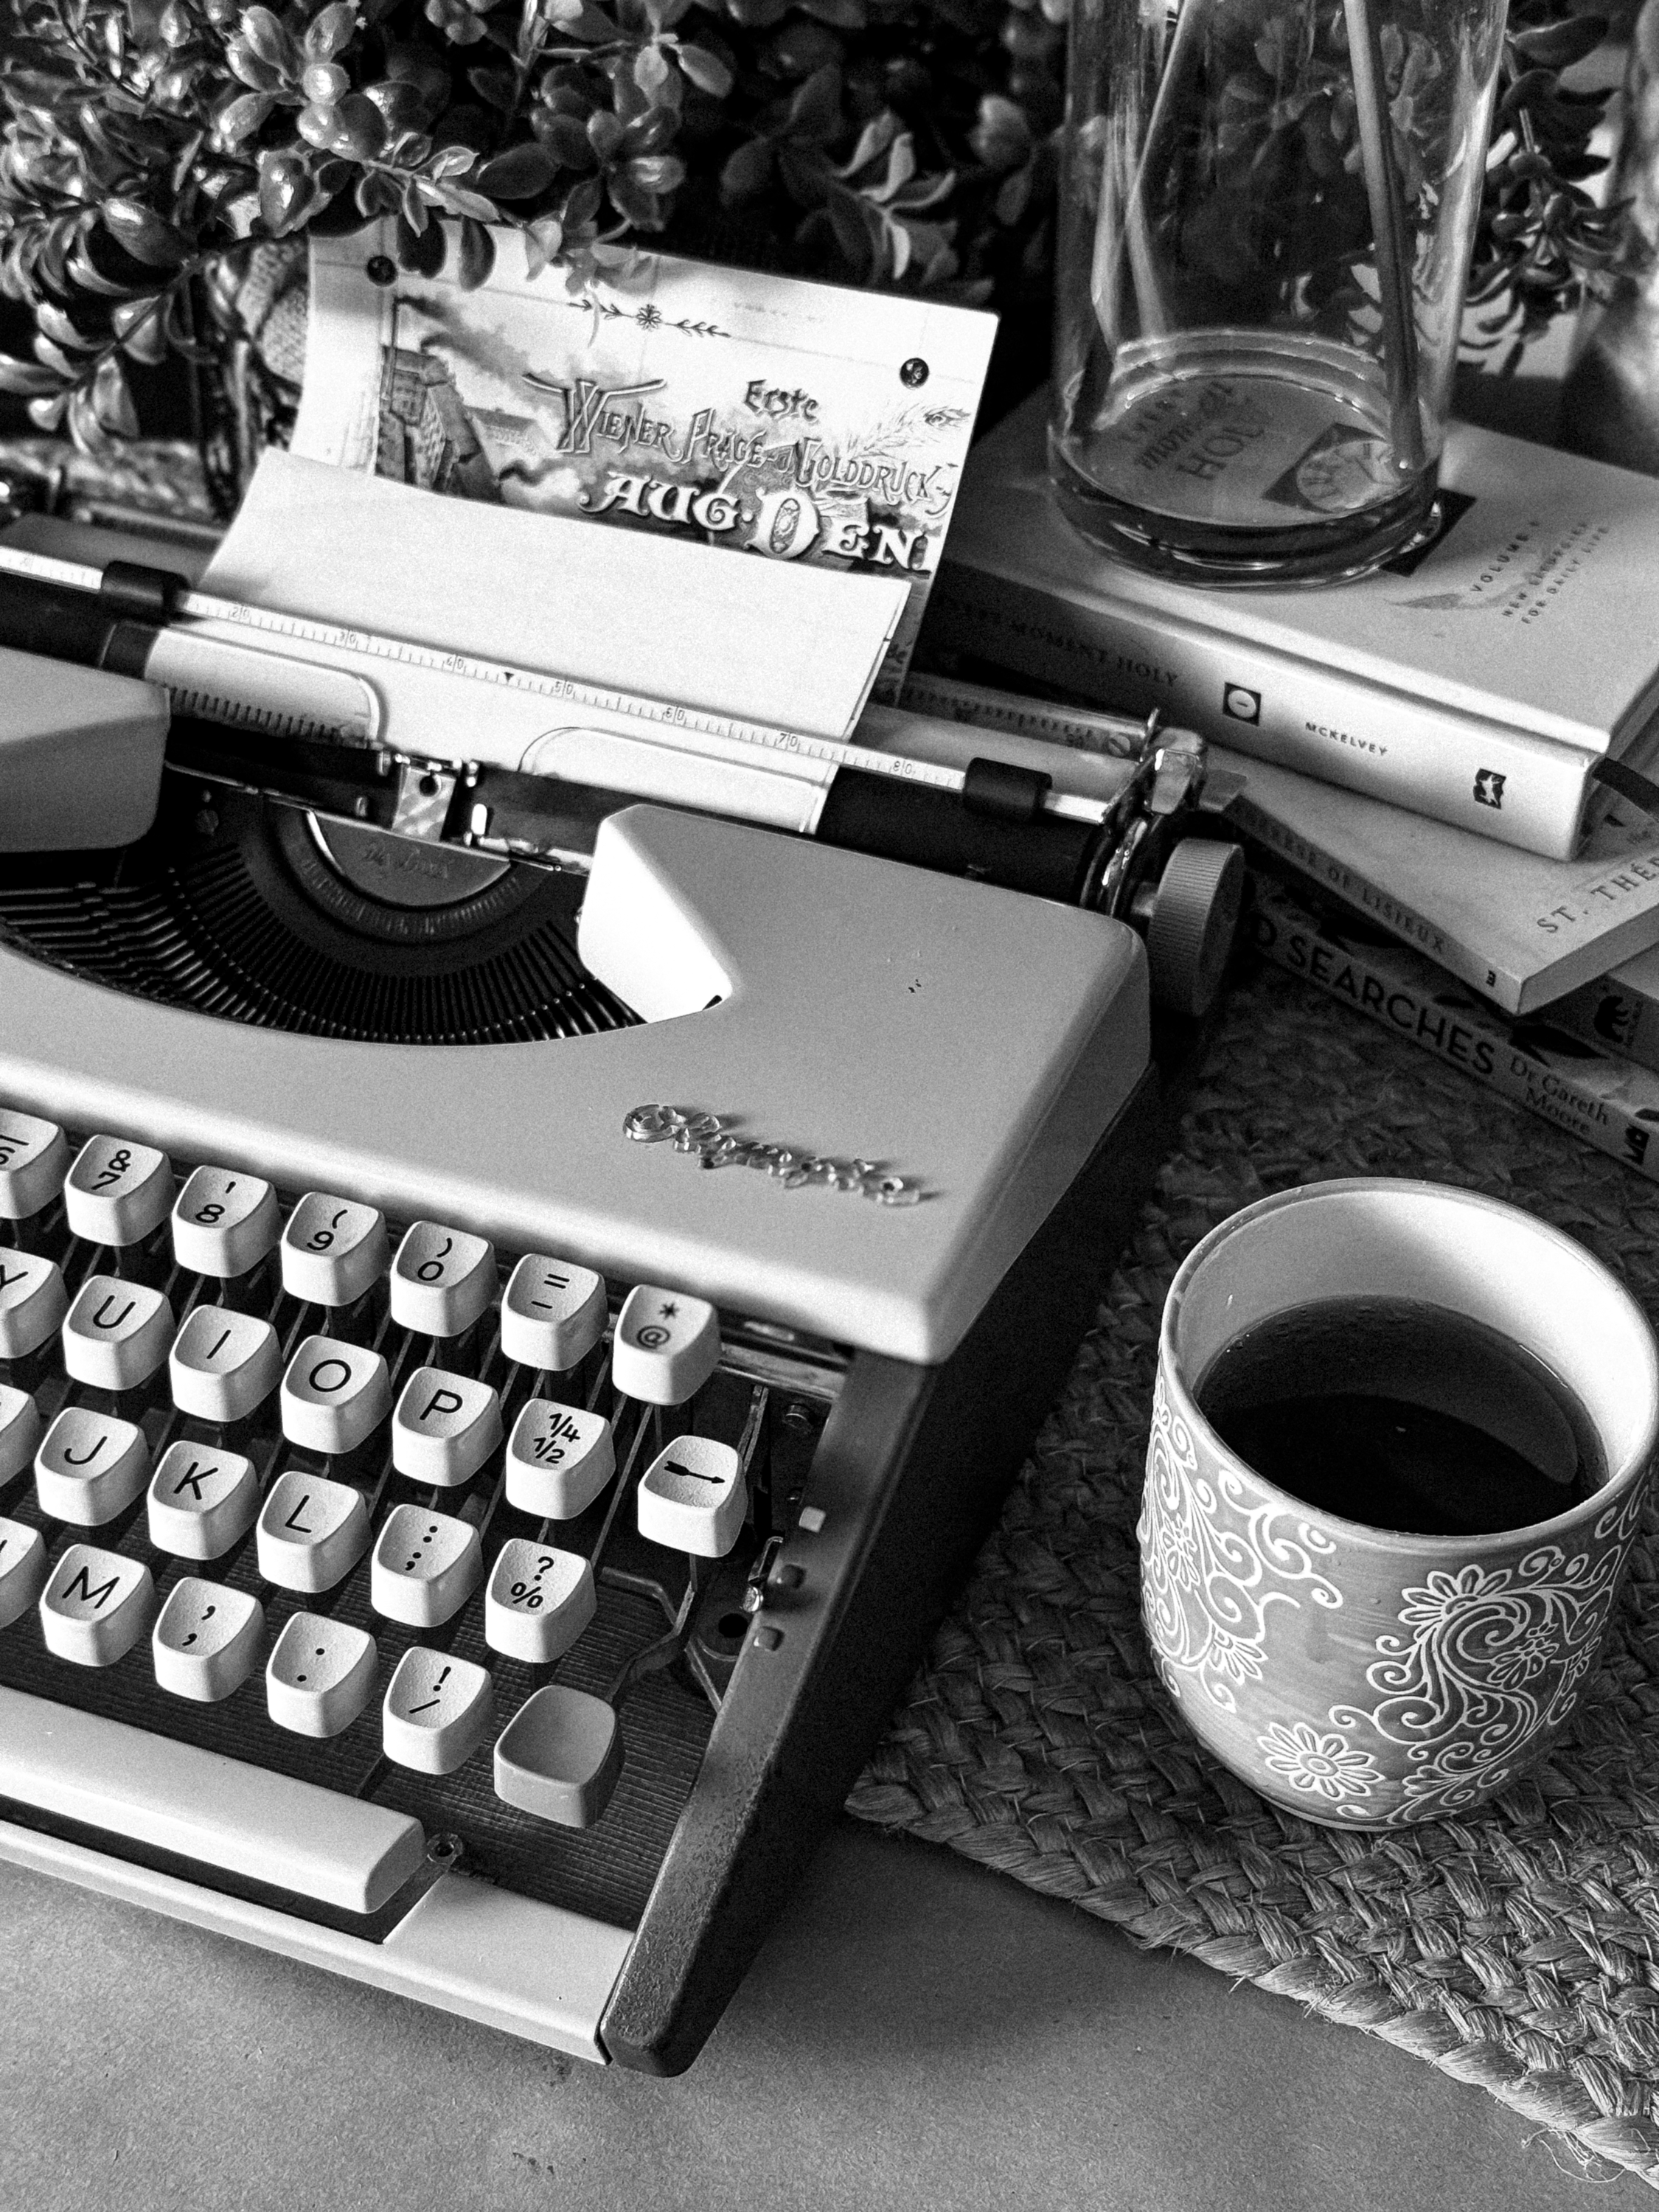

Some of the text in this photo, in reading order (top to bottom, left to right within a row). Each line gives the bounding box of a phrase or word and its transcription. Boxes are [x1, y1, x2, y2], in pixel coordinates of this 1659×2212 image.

[743, 378, 820, 423] Erste
[1470, 532, 1529, 592] VOLUME
[1501, 591, 1528, 618] NEW
[1520, 599, 1547, 625] FOR
[1546, 557, 1581, 594] DAILY
[1116, 655, 1179, 688] HOLY
[779, 731, 798, 748] 70
[1305, 720, 1389, 757] MCKELVEY
[1361, 886, 1447, 955] LISIEUX
[1537, 905, 1588, 933] ST.
[1287, 934, 1495, 1074] SEARCHES
[1511, 1056, 1607, 1126] Dr Gareth
[1526, 1086, 1590, 1134] Moore
[108, 1150, 131, 1172] &
[91, 1171, 122, 1190] 7
[195, 1203, 225, 1224] 8
[306, 1230, 334, 1251] 9
[93, 1295, 136, 1329] U
[636, 1325, 671, 1349] @
[307, 1359, 352, 1393] O
[419, 1388, 463, 1421] P
[63, 1436, 107, 1465] J
[173, 1461, 218, 1500] K
[284, 1495, 311, 1534] L
[534, 1556, 554, 1581] ?
[61, 1566, 119, 1609] M
[509, 1581, 544, 1609] %
